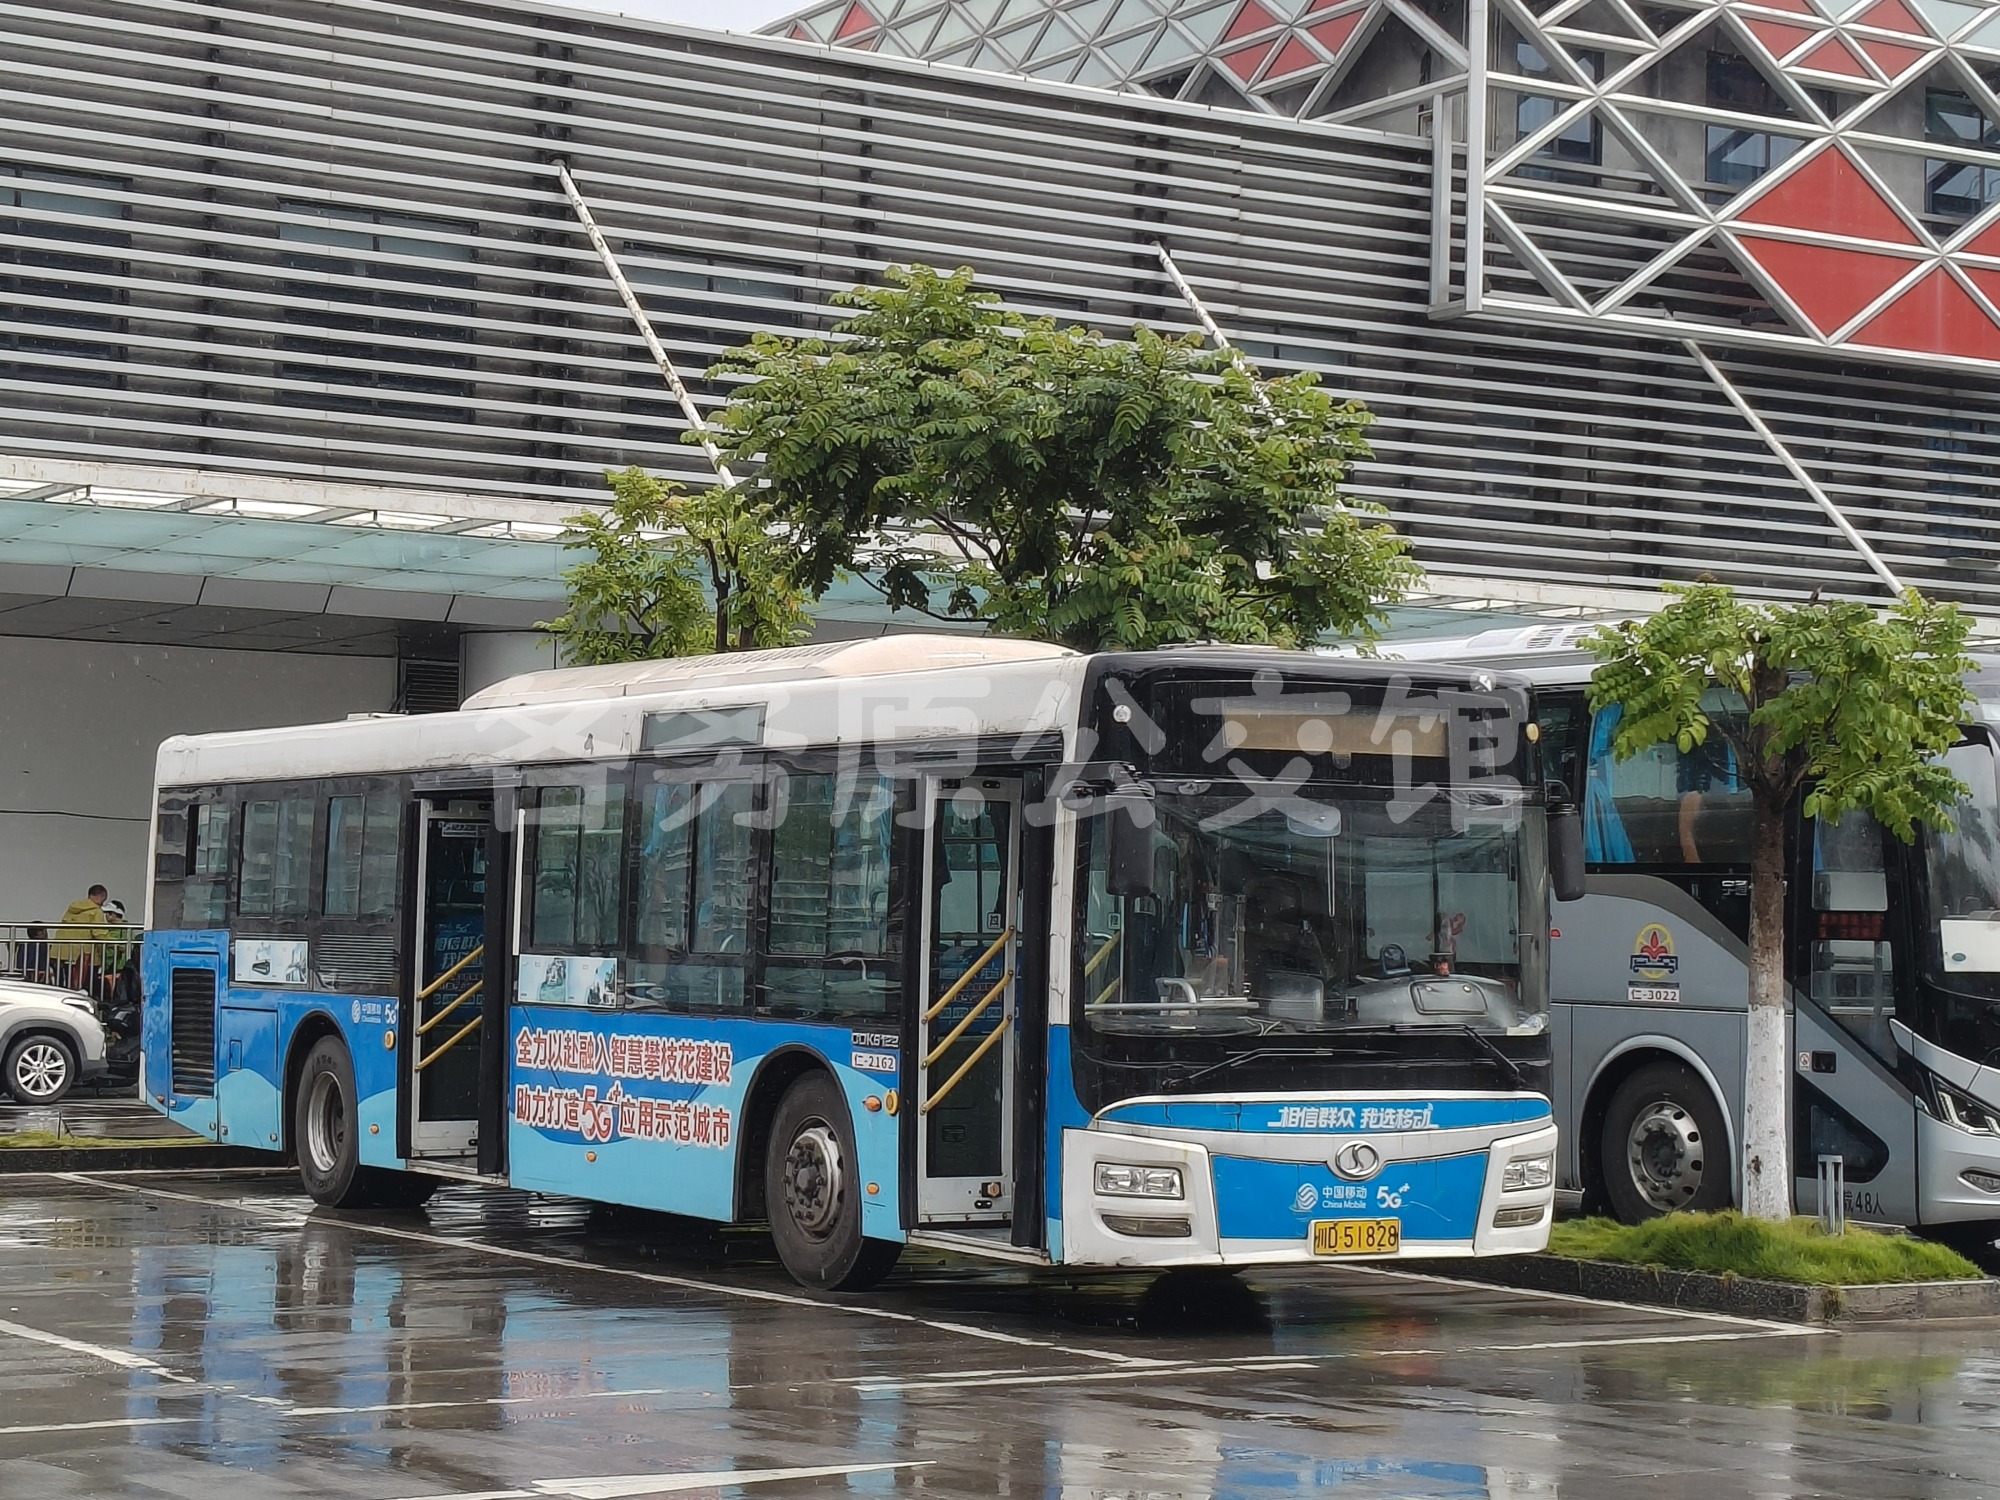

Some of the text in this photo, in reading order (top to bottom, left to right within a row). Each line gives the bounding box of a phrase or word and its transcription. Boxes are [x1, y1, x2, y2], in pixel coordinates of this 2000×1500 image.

[516, 1027, 733, 1086] 全力以赴融入智慧攀枝花建设
[1268, 1102, 1439, 1128] 相信群众 我选移动
[1322, 1185, 1367, 1200] 中国移动
[1322, 1200, 1367, 1209] China Mobile
[1834, 1189, 1885, 1216] 载48人
